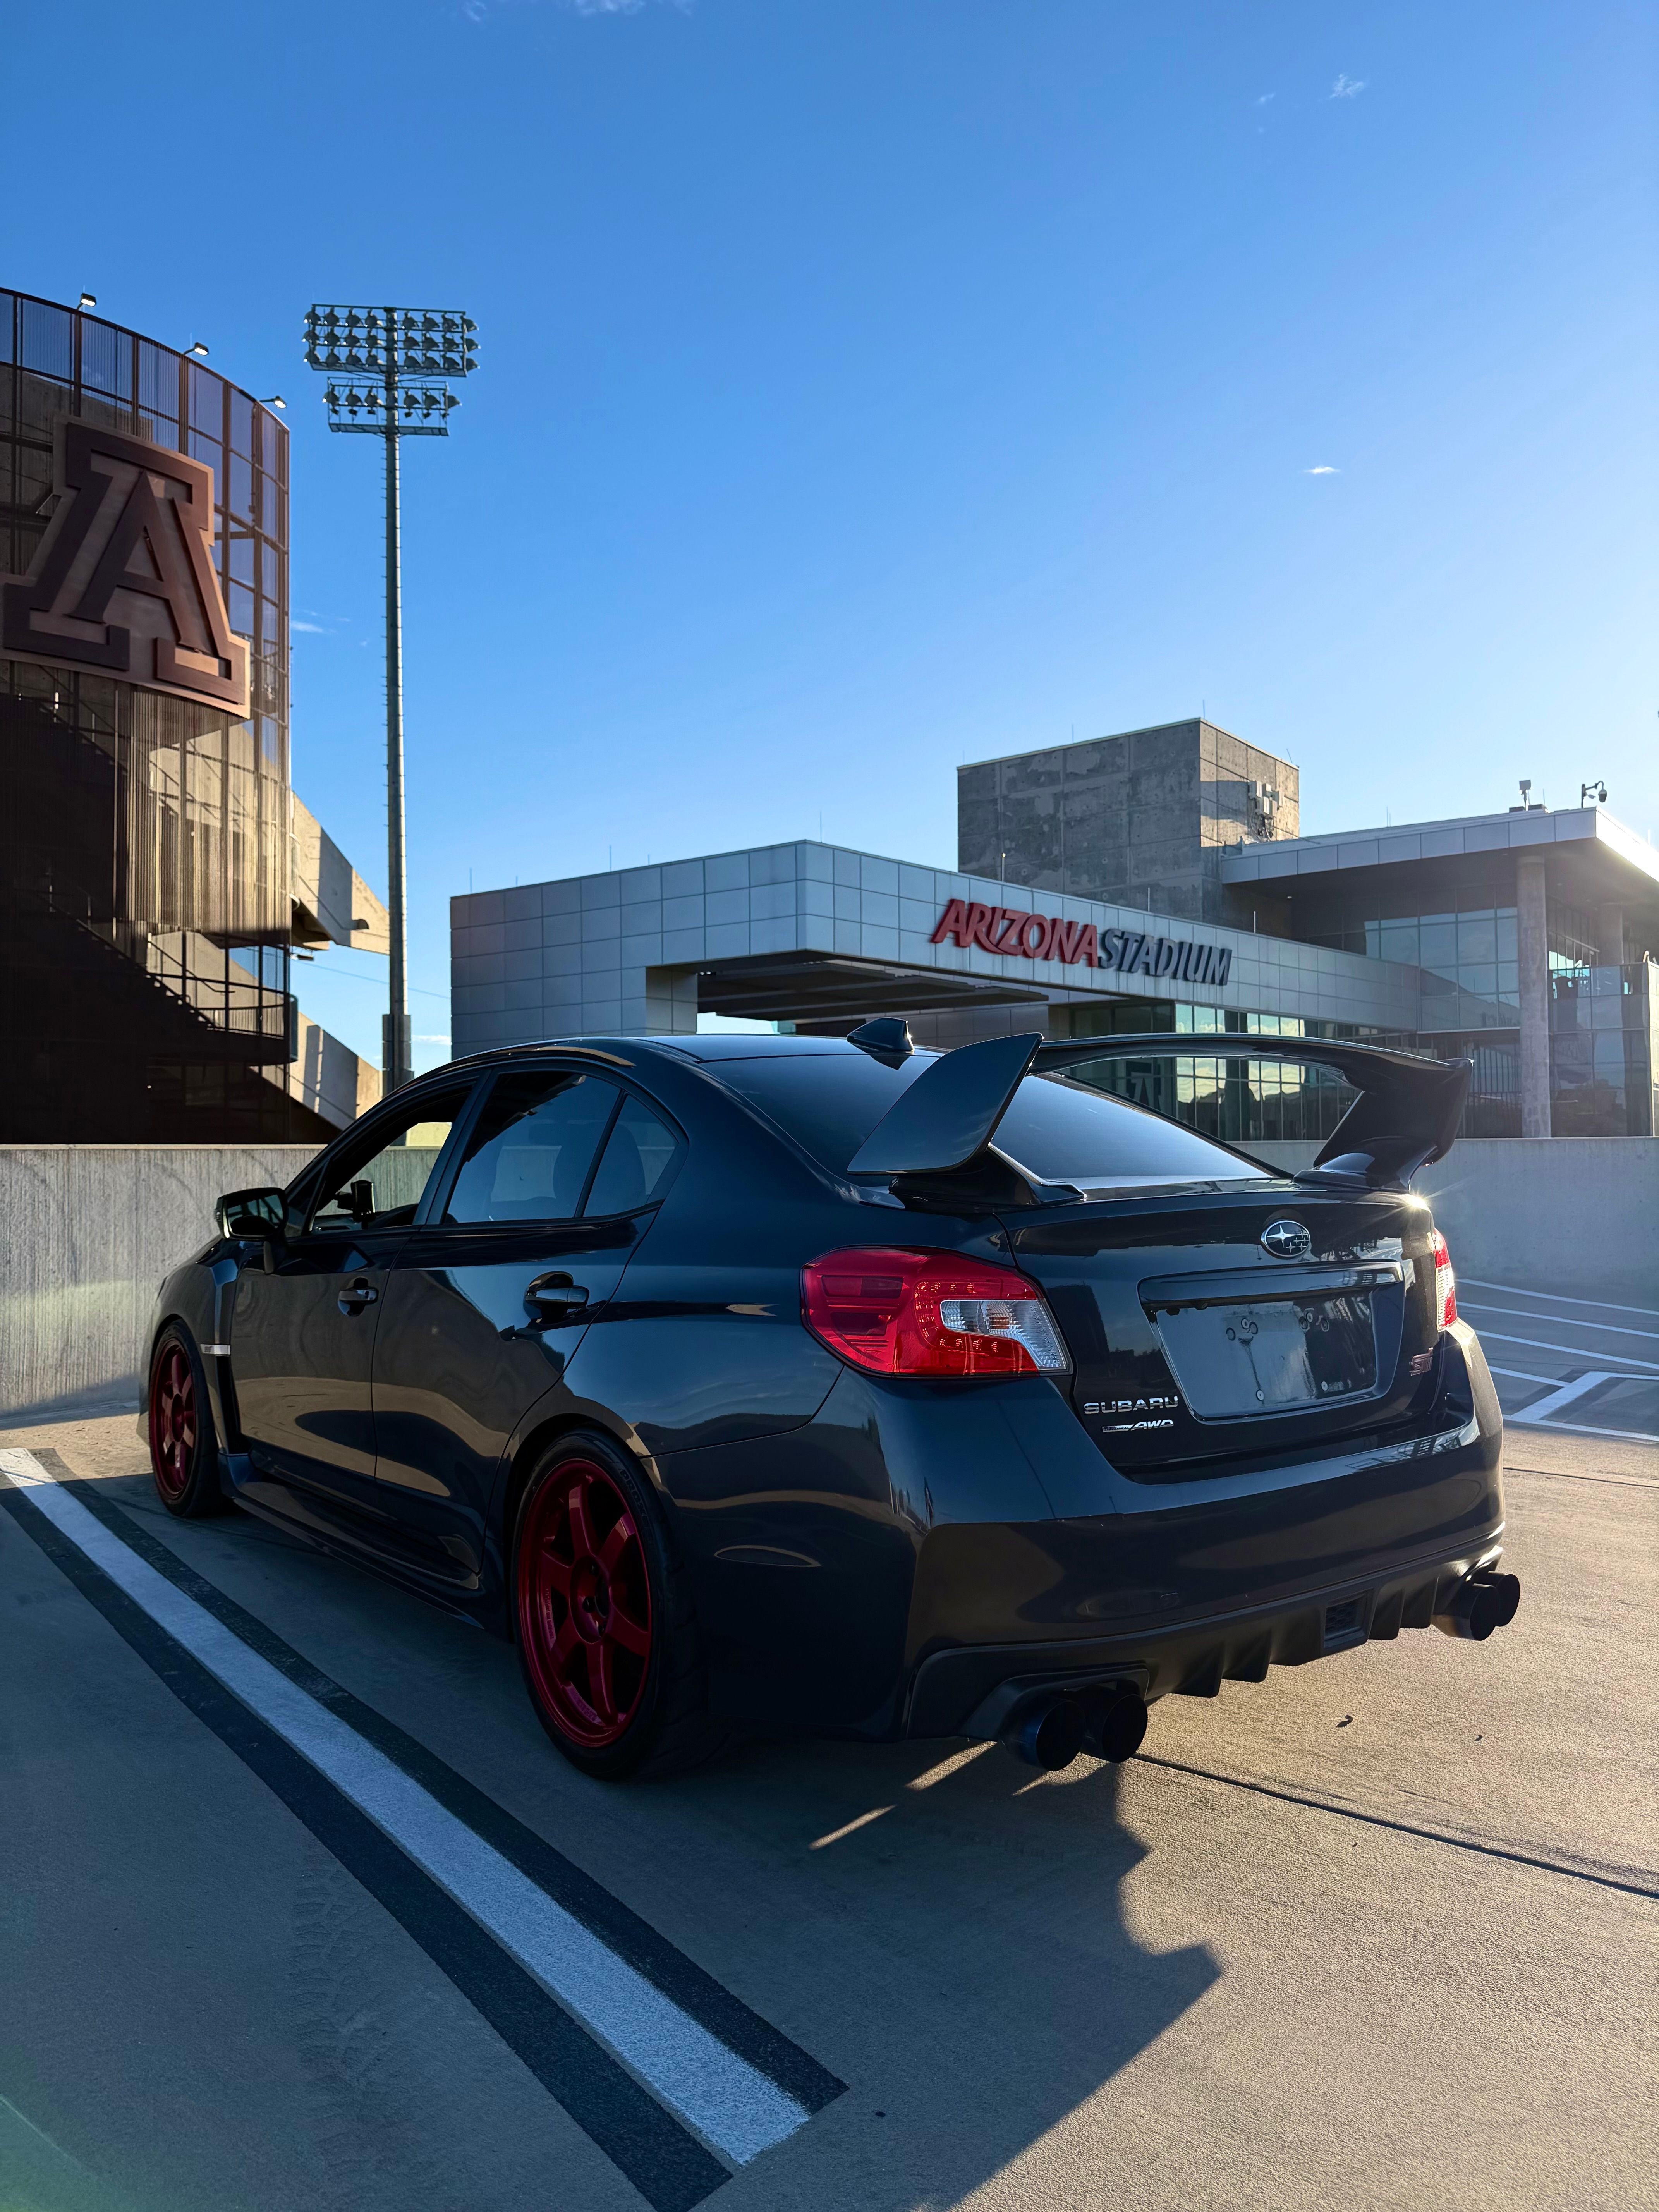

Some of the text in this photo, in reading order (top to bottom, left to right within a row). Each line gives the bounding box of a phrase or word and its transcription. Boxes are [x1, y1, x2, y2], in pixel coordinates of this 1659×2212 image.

[930, 899, 1232, 986] ARIZONA STADIUM
[1084, 1396, 1179, 1415] SUBARU
[1130, 1419, 1174, 1431] AWD
